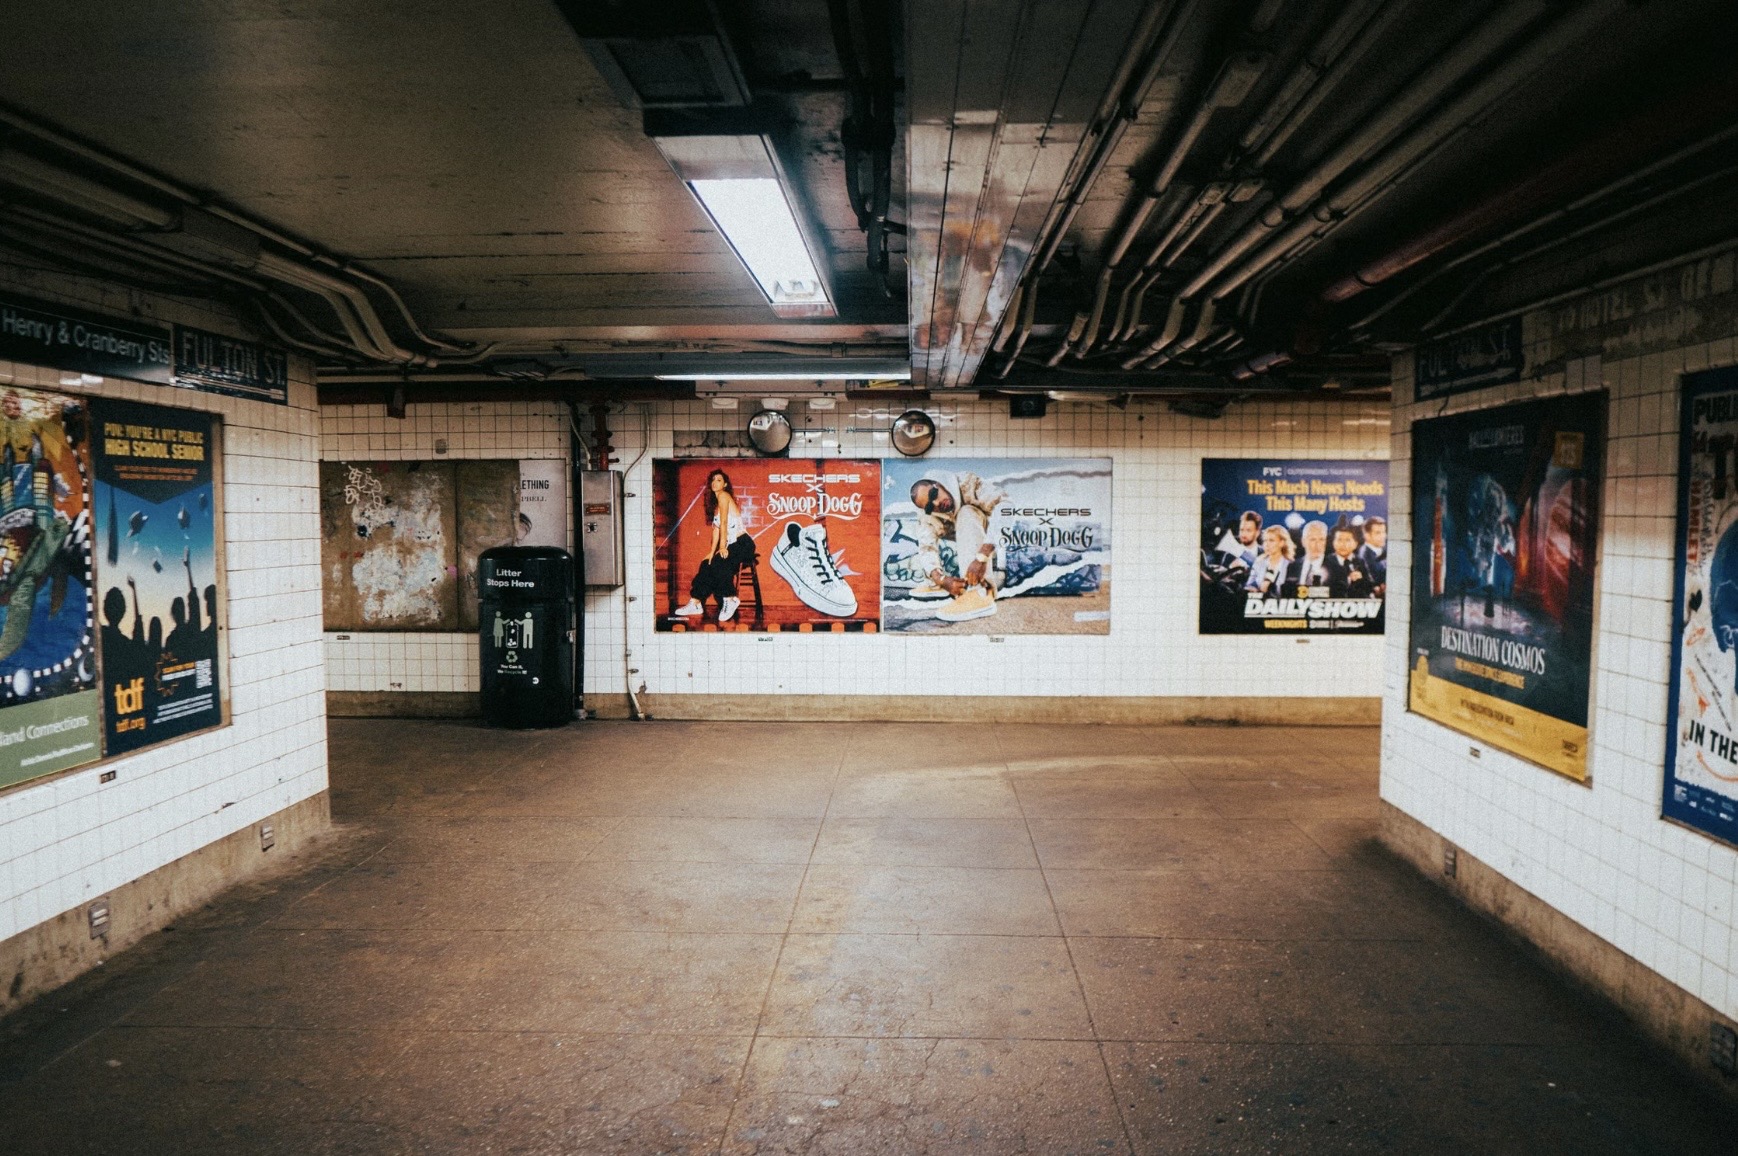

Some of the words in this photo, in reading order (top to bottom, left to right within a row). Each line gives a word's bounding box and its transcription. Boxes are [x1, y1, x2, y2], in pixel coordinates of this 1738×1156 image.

[2, 308, 53, 346] Henry
[58, 320, 70, 345] &
[73, 325, 145, 364] Cranberry
[182, 332, 259, 380] FULTON
[132, 440, 170, 459] SCHOOL
[171, 443, 205, 461] SENIOR
[520, 480, 550, 489] ETHING
[768, 473, 861, 483] SKECHERS
[1247, 479, 1274, 495] This
[1275, 480, 1309, 495] Much
[1310, 480, 1345, 495] News
[1345, 480, 1385, 495] Needs
[805, 483, 824, 493] X
[766, 492, 817, 516] SNOOP
[817, 492, 863, 516] DOGG
[1000, 507, 1092, 517] SKECHERS
[1265, 496, 1293, 511] This
[1293, 496, 1328, 514] Many
[1328, 496, 1366, 511] Hosts
[1038, 517, 1054, 526] X
[999, 527, 1048, 547] SNOOP
[1049, 526, 1094, 549] DOGG
[496, 569, 522, 577] Litter
[487, 579, 509, 588] Stops
[511, 580, 535, 588] Here
[1245, 599, 1313, 616] DAILY
[1308, 600, 1383, 618] SHOW
[1441, 625, 1500, 663] DESTINATION
[1501, 640, 1546, 675] COSMOS
[114, 677, 145, 715] tdf
[26, 715, 90, 740] Connections
[1689, 719, 1706, 747] IN
[1710, 729, 1738, 765] THE
